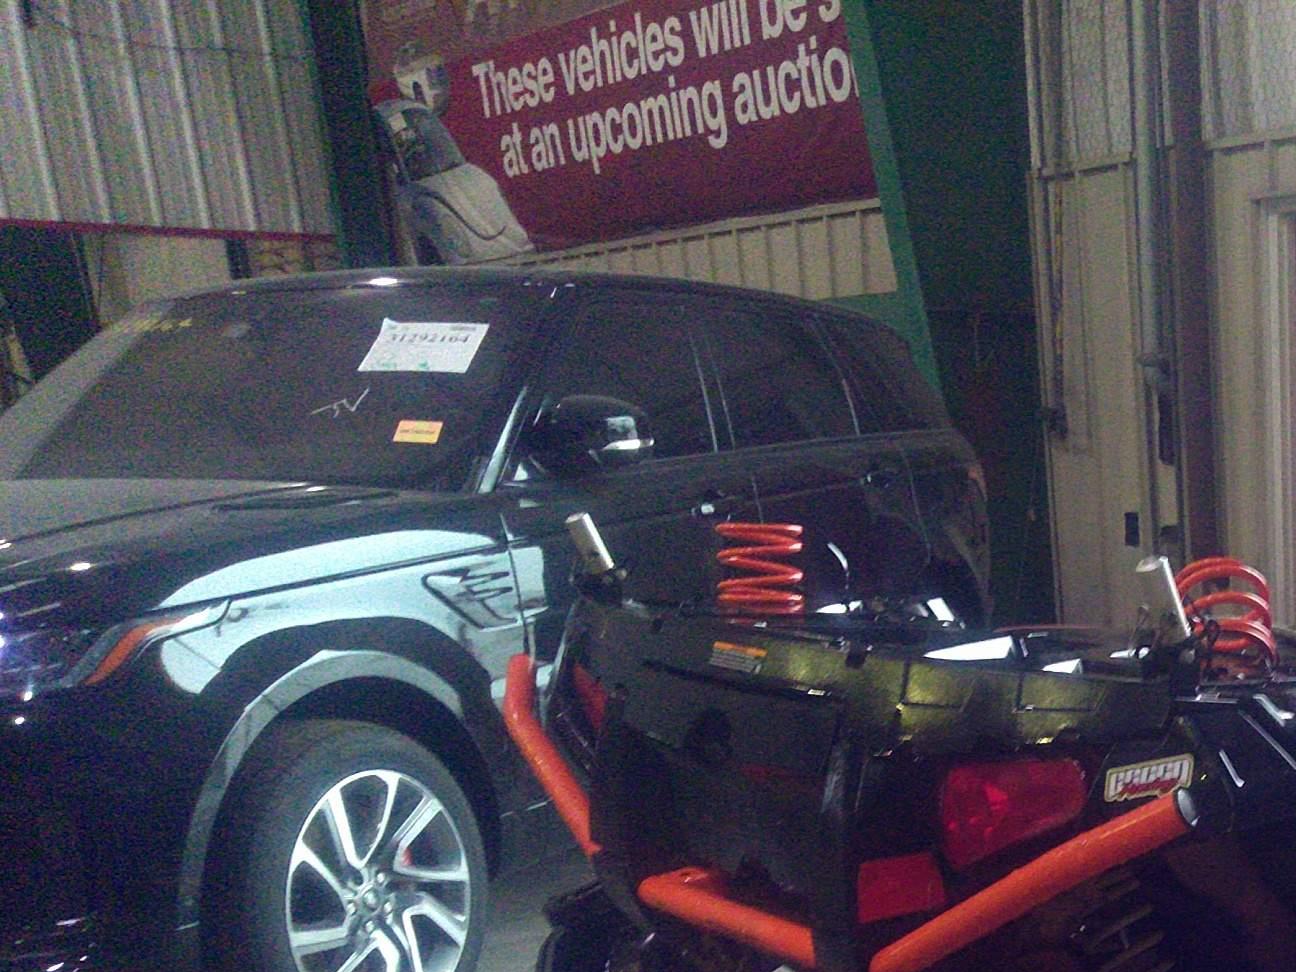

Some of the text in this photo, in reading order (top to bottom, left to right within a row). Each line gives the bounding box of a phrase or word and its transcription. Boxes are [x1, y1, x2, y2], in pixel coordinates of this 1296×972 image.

[471, 0, 808, 118] These vehicles will be
[501, 35, 860, 178] at an upcoming auctio
